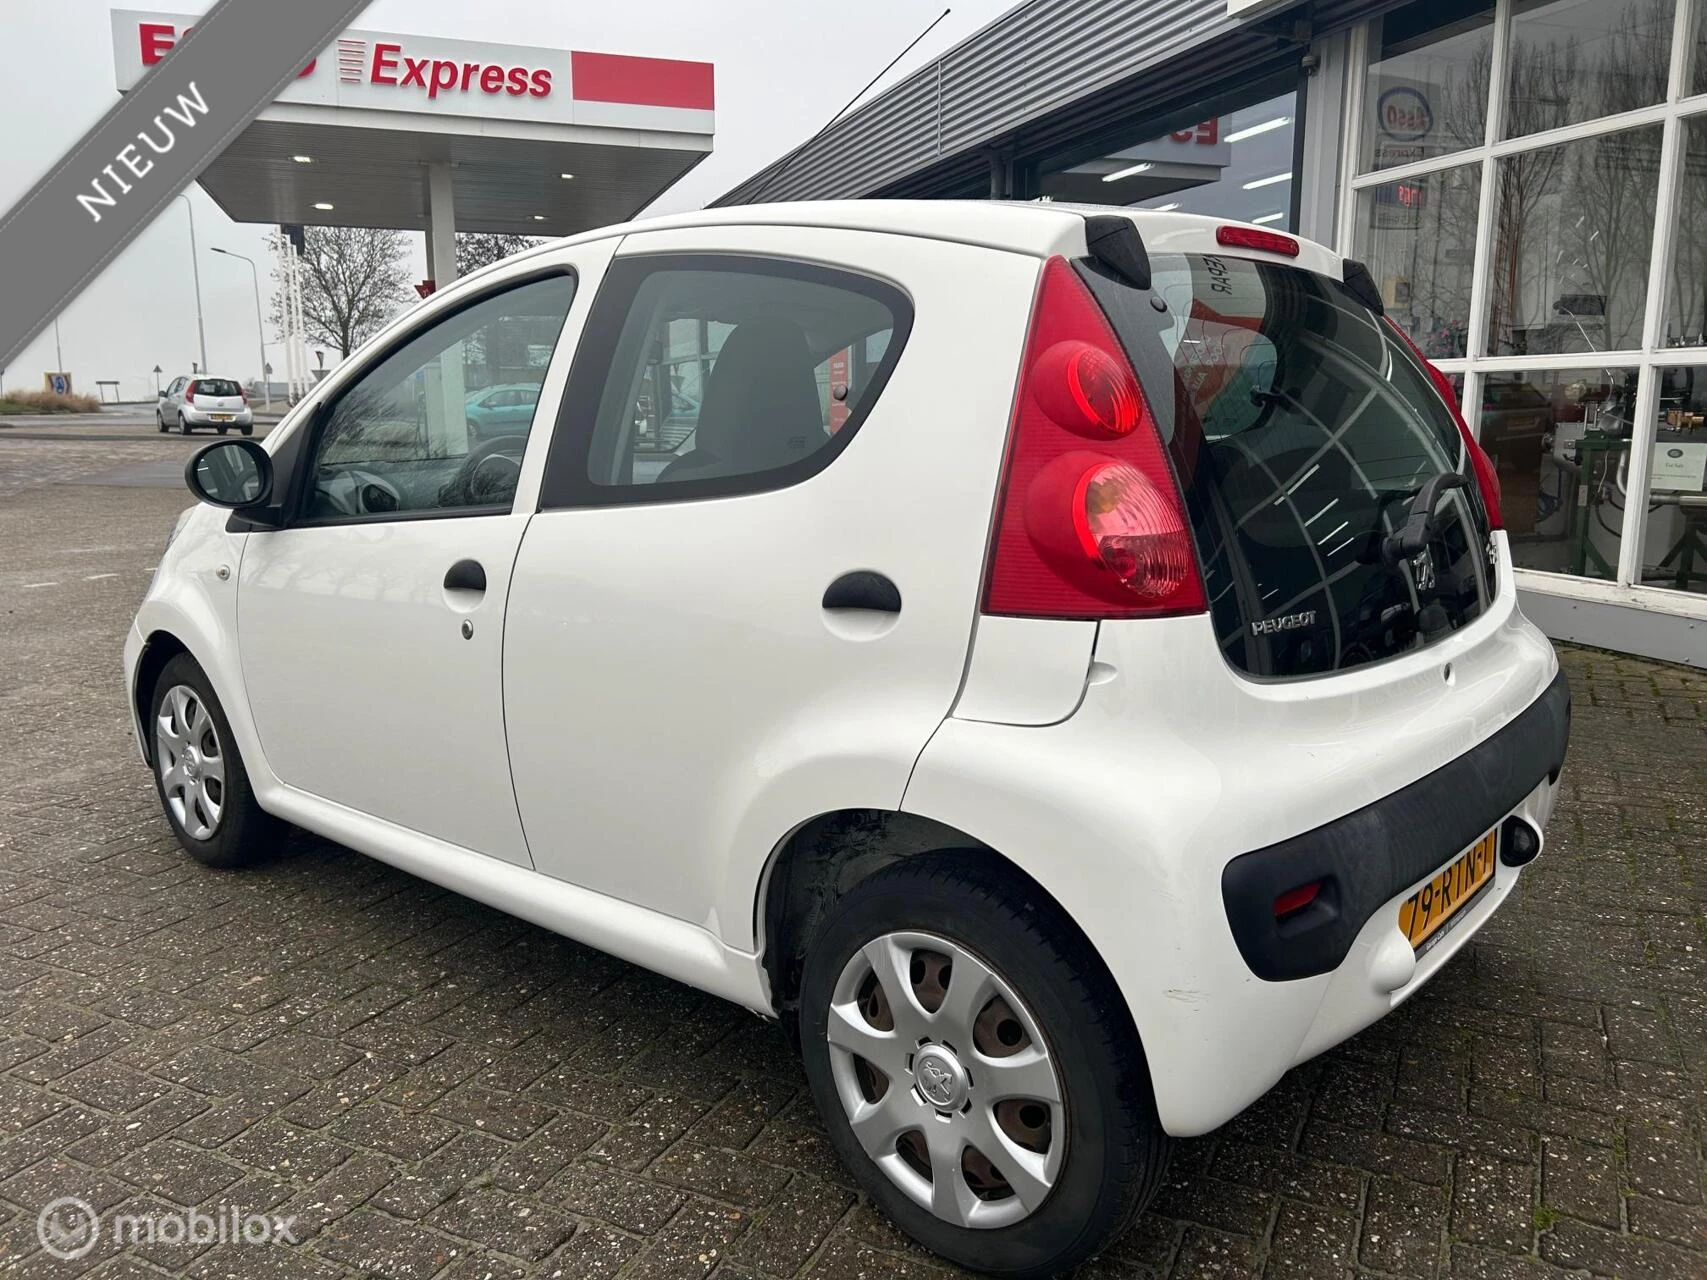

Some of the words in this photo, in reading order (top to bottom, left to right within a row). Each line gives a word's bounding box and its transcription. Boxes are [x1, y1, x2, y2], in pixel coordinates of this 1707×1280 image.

[371, 43, 552, 99] Express
[1251, 610, 1317, 636] PEUGEOT
[1407, 836, 1488, 942] 79-RTN-1
